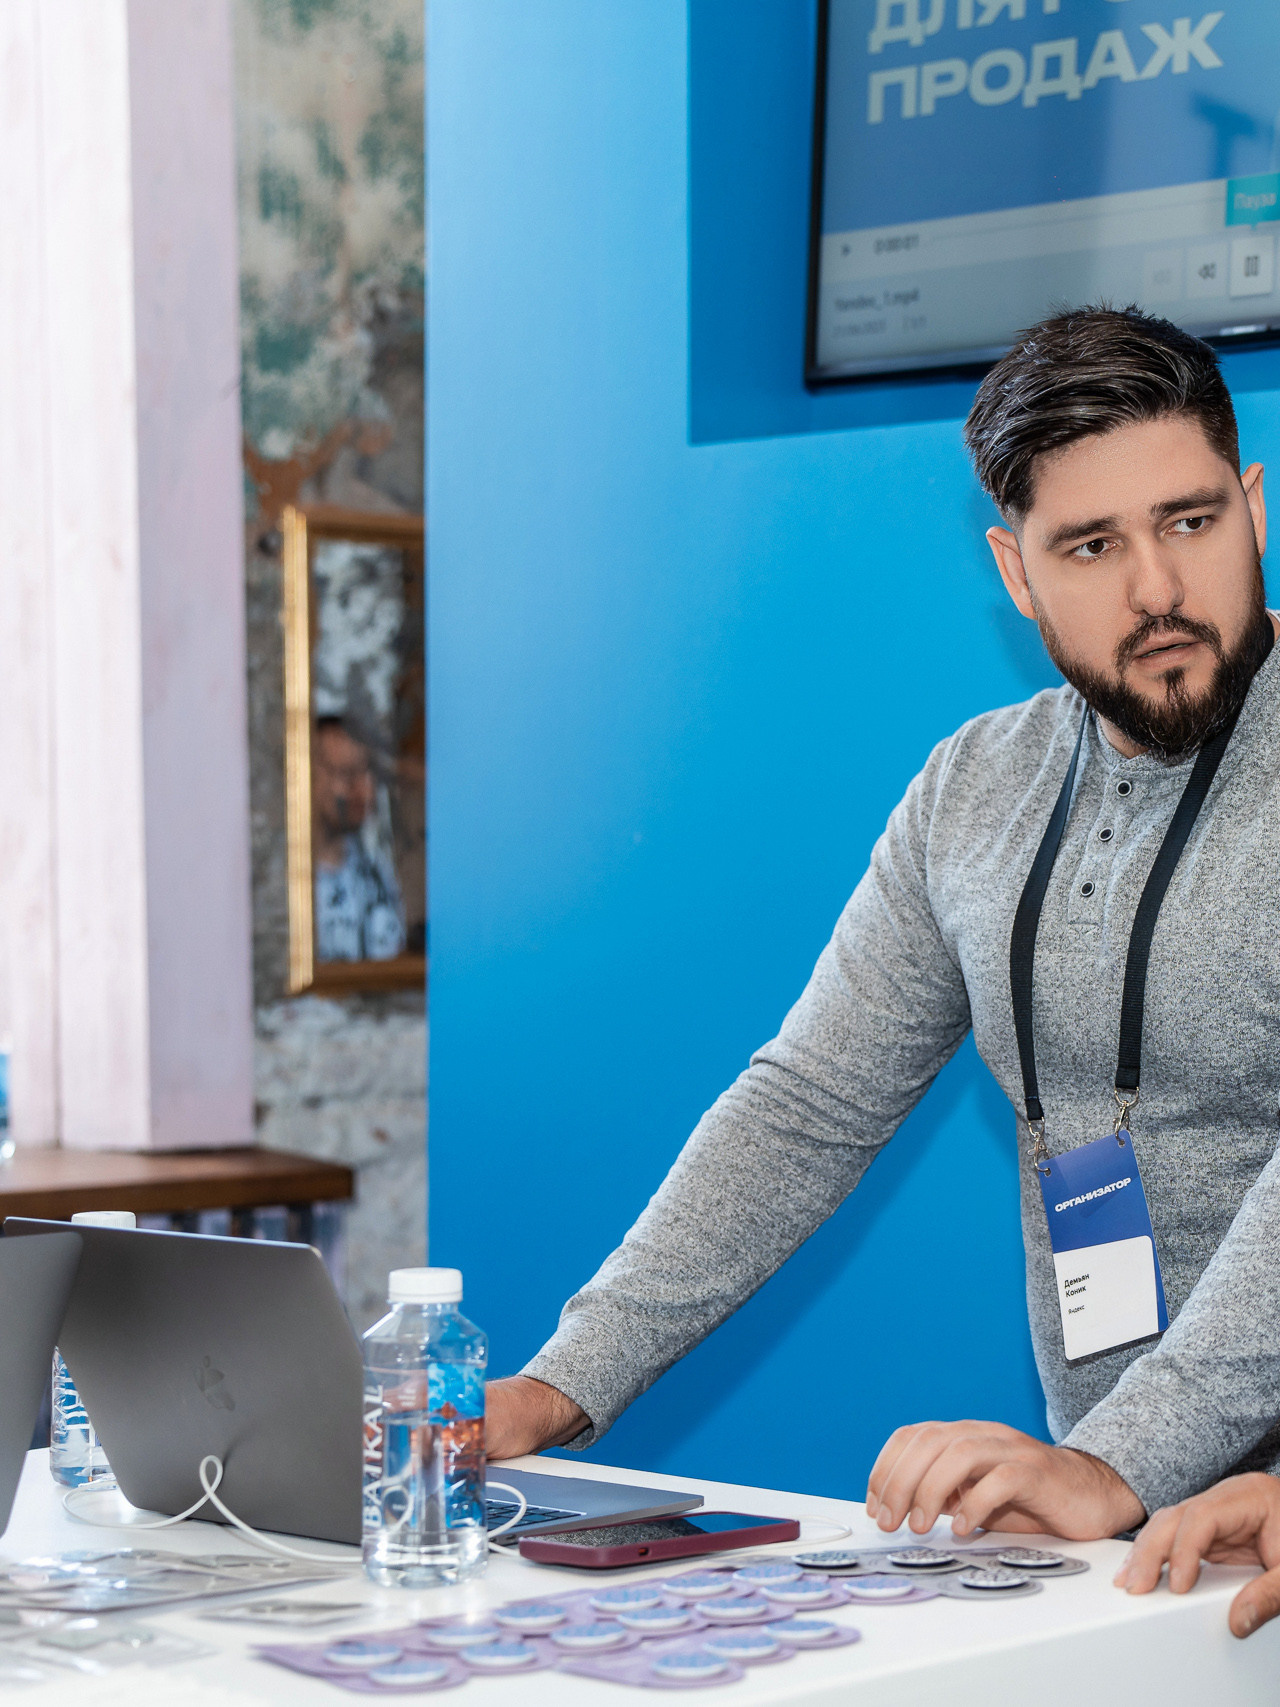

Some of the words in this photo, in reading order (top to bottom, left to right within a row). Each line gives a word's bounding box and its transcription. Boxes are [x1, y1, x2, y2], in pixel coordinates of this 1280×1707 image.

[867, 11, 1225, 124] ПРОДАЖ
[1054, 1177, 1132, 1213] ОРГАНИЗАТОР
[1064, 1273, 1090, 1289] Демьян
[363, 1384, 384, 1528] BAIKAL
